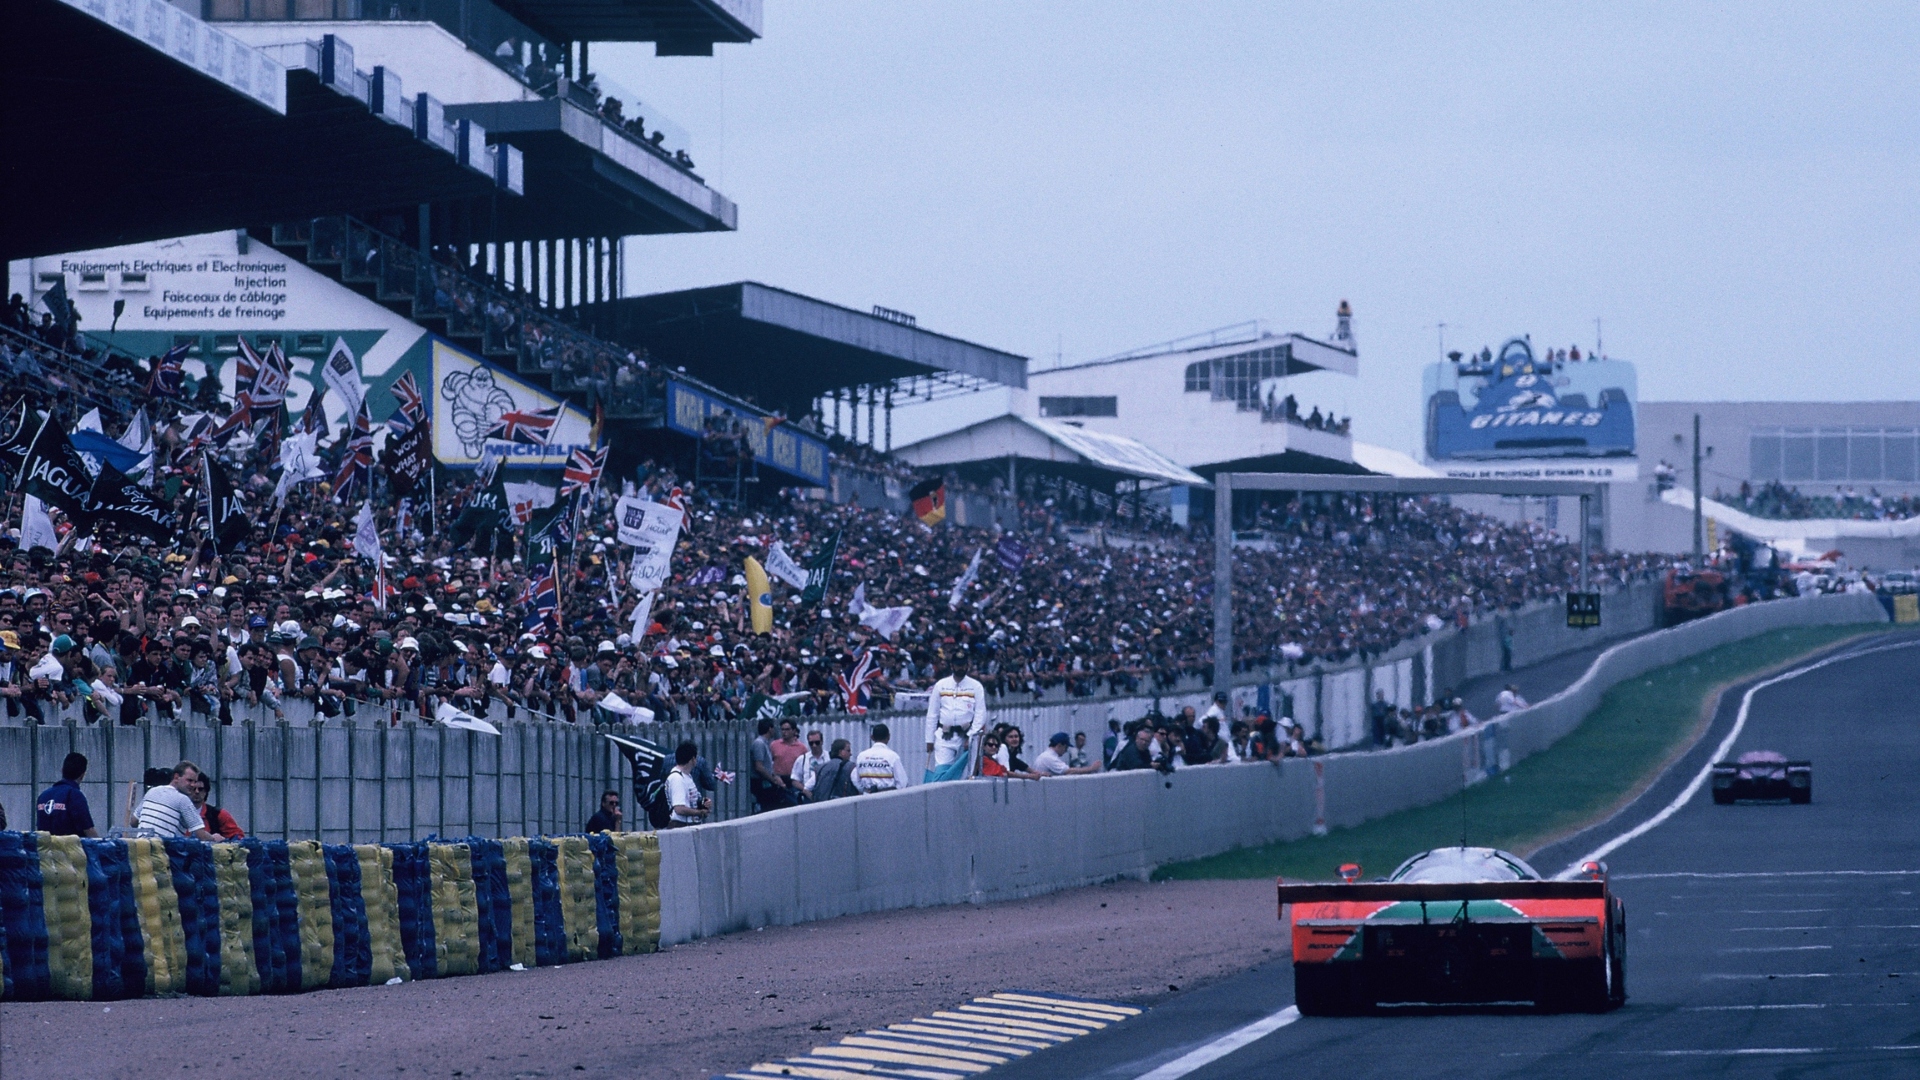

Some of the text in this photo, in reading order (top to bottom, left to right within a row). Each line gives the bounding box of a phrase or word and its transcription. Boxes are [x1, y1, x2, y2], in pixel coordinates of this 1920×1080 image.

[134, 260, 192, 272] Electriques
[197, 261, 207, 271] et
[212, 260, 286, 272] Electroniques
[235, 277, 286, 290] Injection
[164, 291, 286, 304] Faisceaux de câblage
[144, 306, 286, 319] Equipements de freinage
[1470, 412, 1602, 429] GITANES
